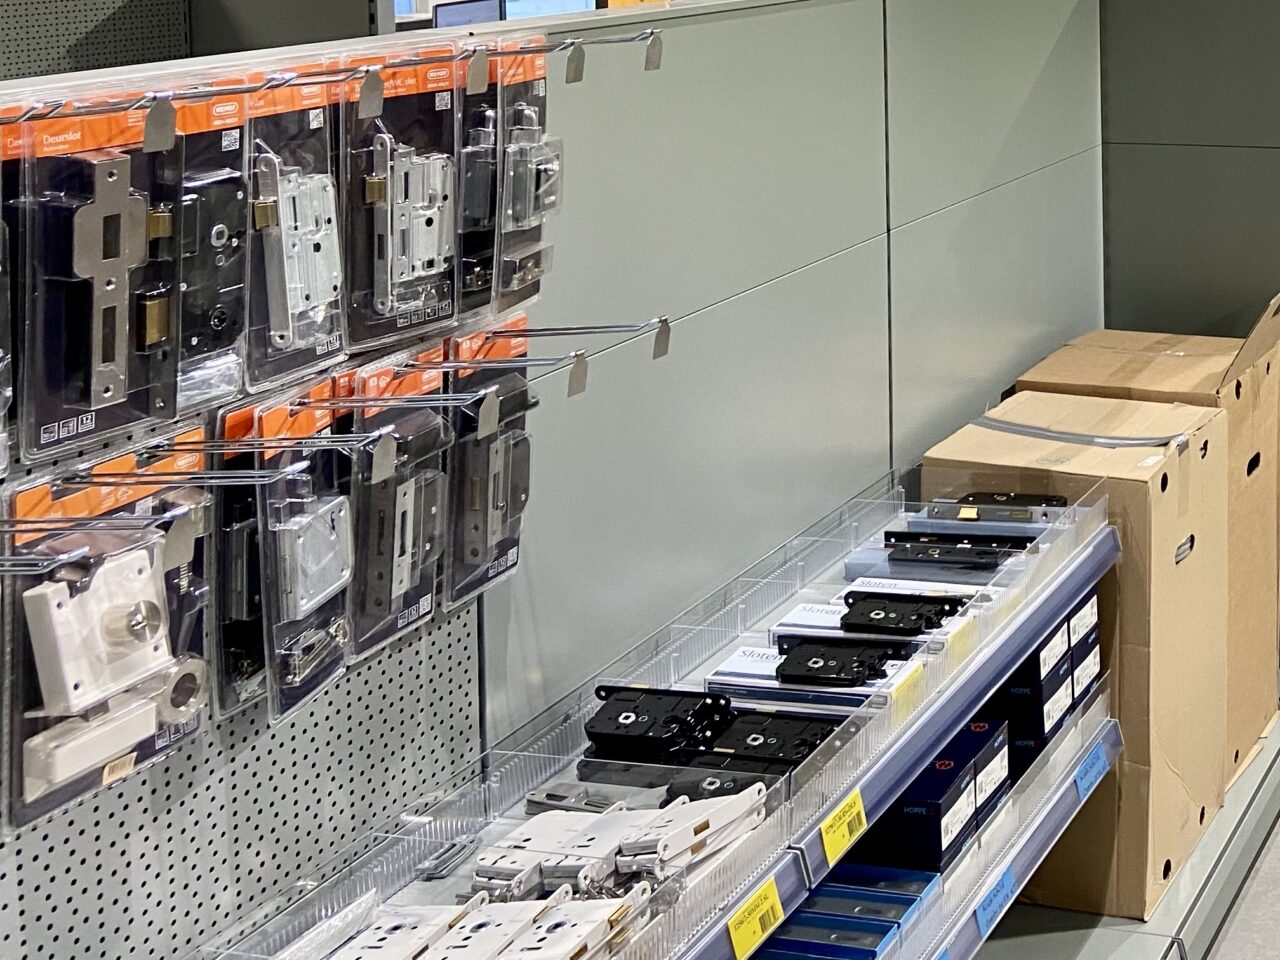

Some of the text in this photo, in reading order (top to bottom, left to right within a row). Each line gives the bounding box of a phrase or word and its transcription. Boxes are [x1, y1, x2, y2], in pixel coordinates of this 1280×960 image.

[43, 131, 82, 142] Deurslot
[860, 579, 898, 589] Sloten
[801, 605, 842, 616] Sloten
[738, 649, 783, 661] Sloten
